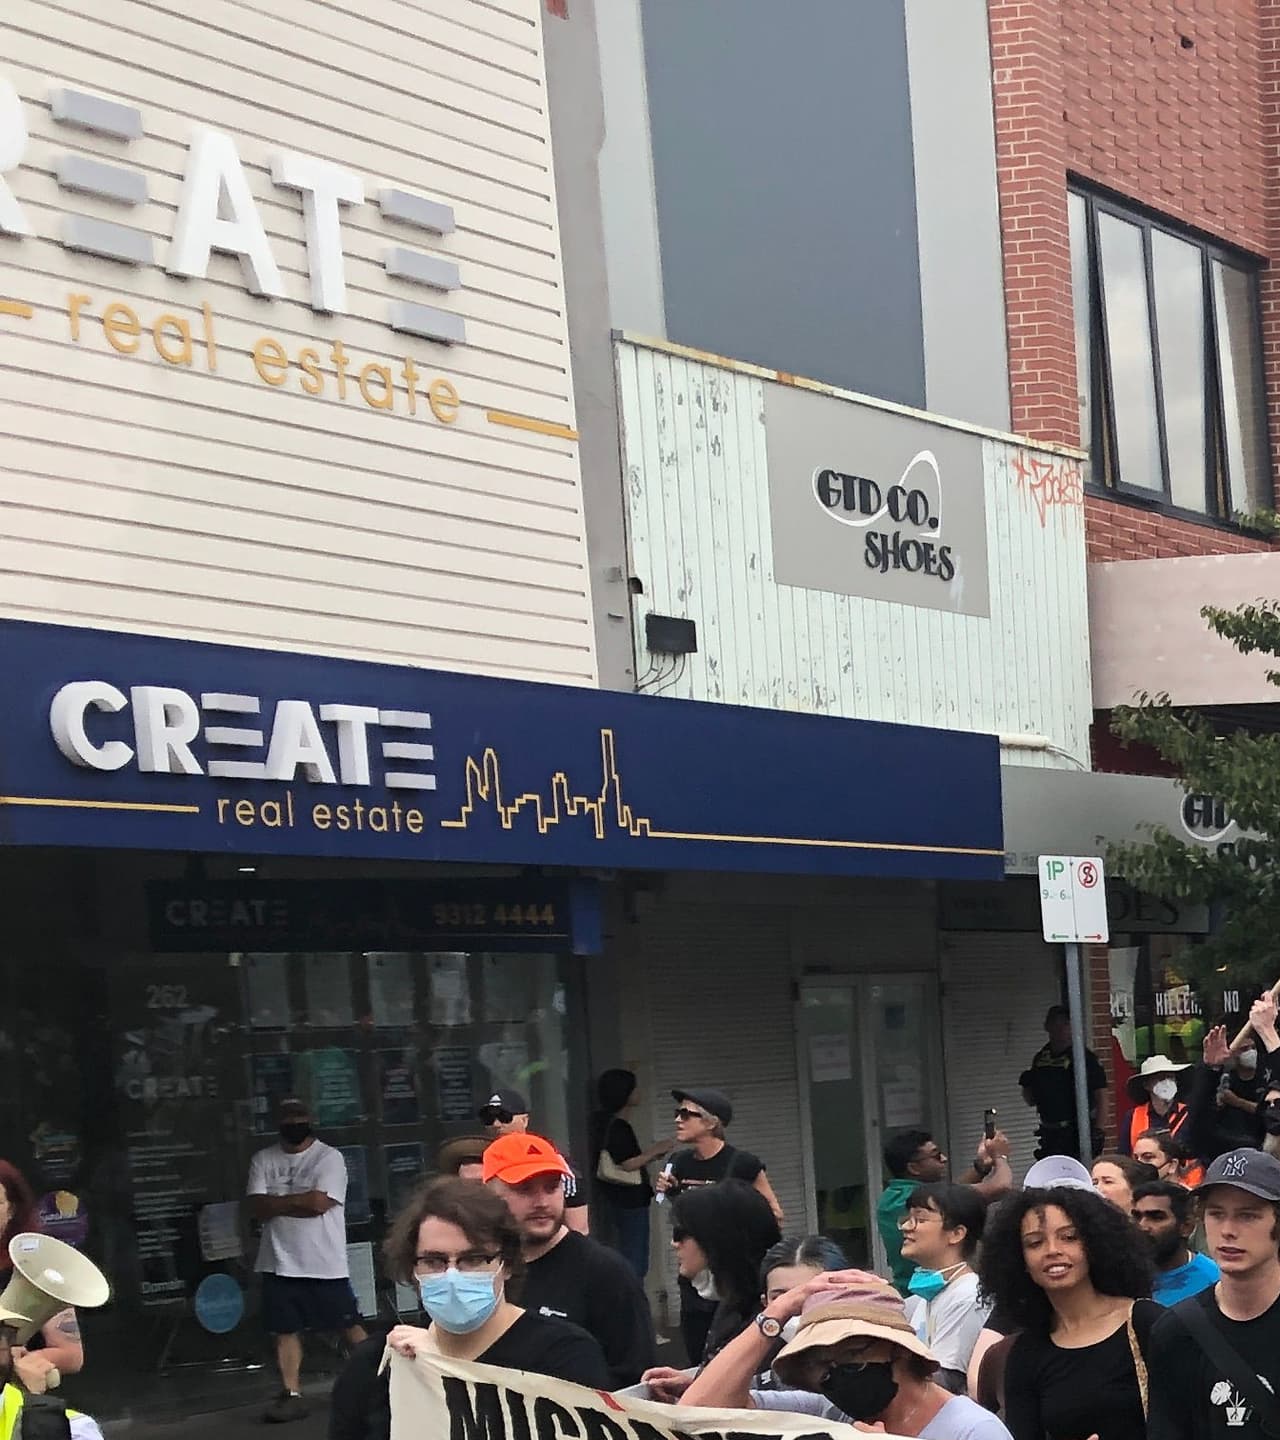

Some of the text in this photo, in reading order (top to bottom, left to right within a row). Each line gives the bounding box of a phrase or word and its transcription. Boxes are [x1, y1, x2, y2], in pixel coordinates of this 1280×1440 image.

[67, 292, 462, 424] real estate
[817, 469, 939, 530] GTD CO.
[864, 531, 955, 582] SHOES
[50, 681, 437, 790] CREATE
[217, 791, 425, 833] real estate
[1046, 861, 1064, 881] 1P
[164, 899, 288, 927] CREATE
[493, 903, 555, 926] 4444
[1223, 990, 1240, 1013] NO
[125, 1075, 217, 1099] CREATE
